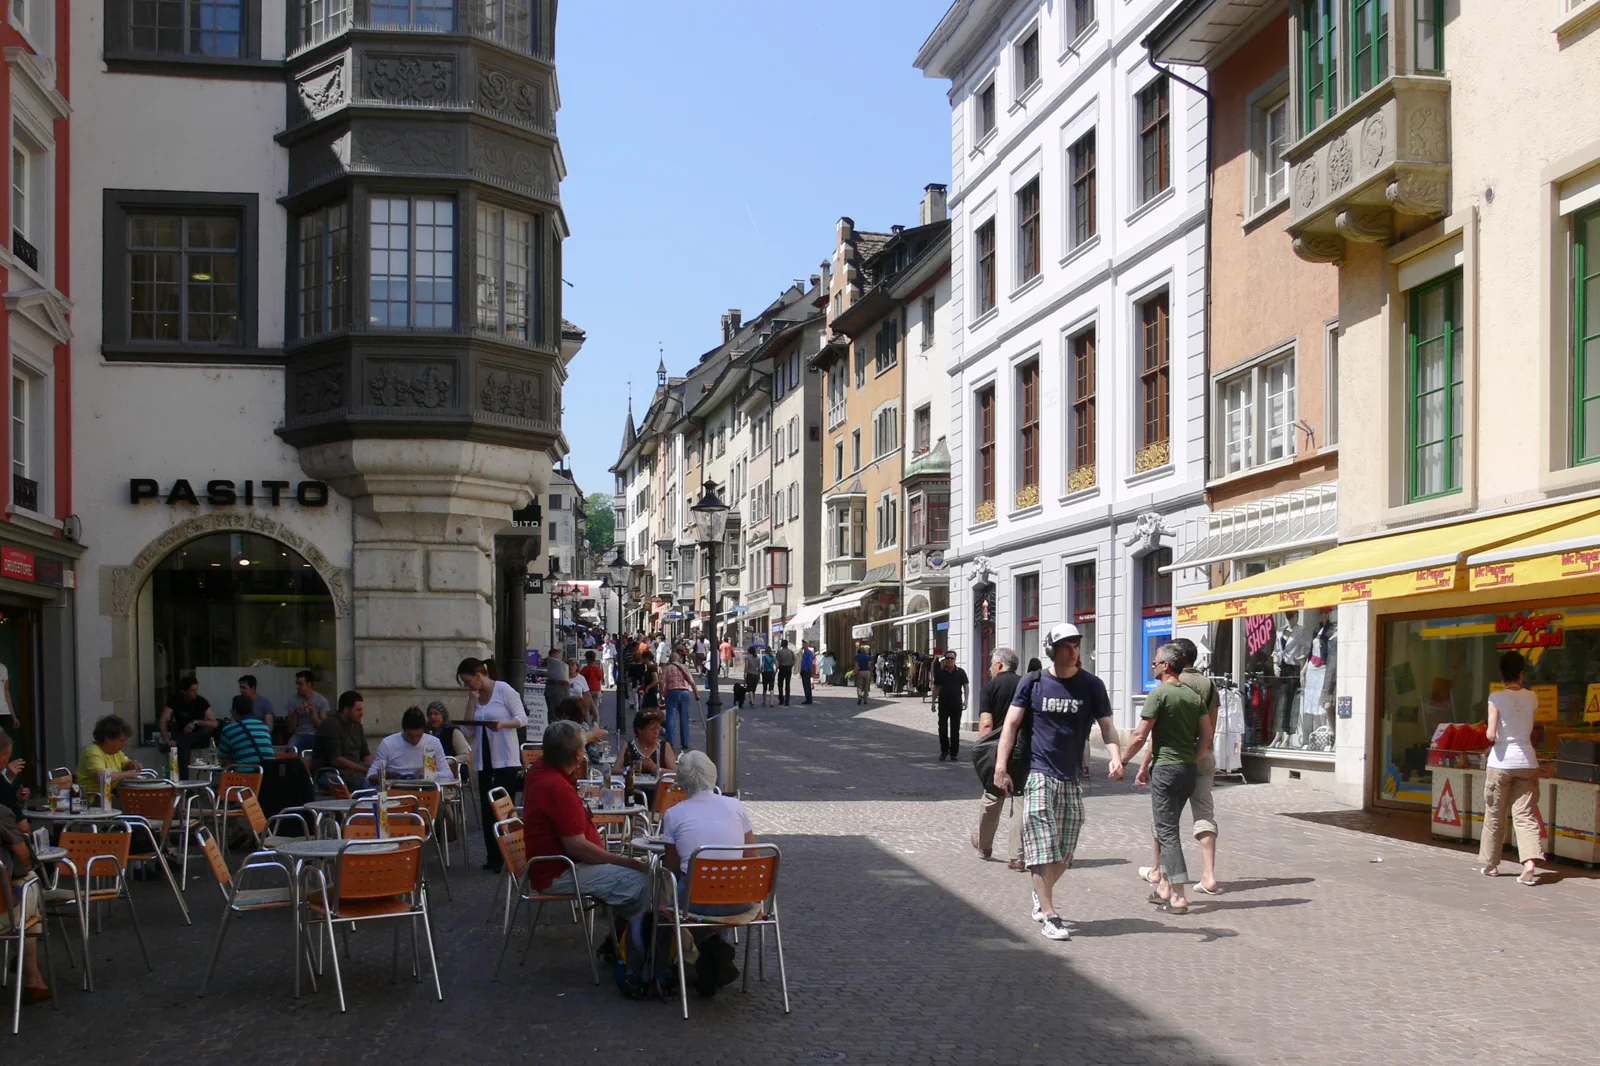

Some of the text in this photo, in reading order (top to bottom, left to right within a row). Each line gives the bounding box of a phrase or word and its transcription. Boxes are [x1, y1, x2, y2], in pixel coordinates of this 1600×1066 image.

[130, 479, 329, 507] PASITO
[1245, 614, 1271, 637] MOD
[1248, 619, 1273, 656] SHOP
